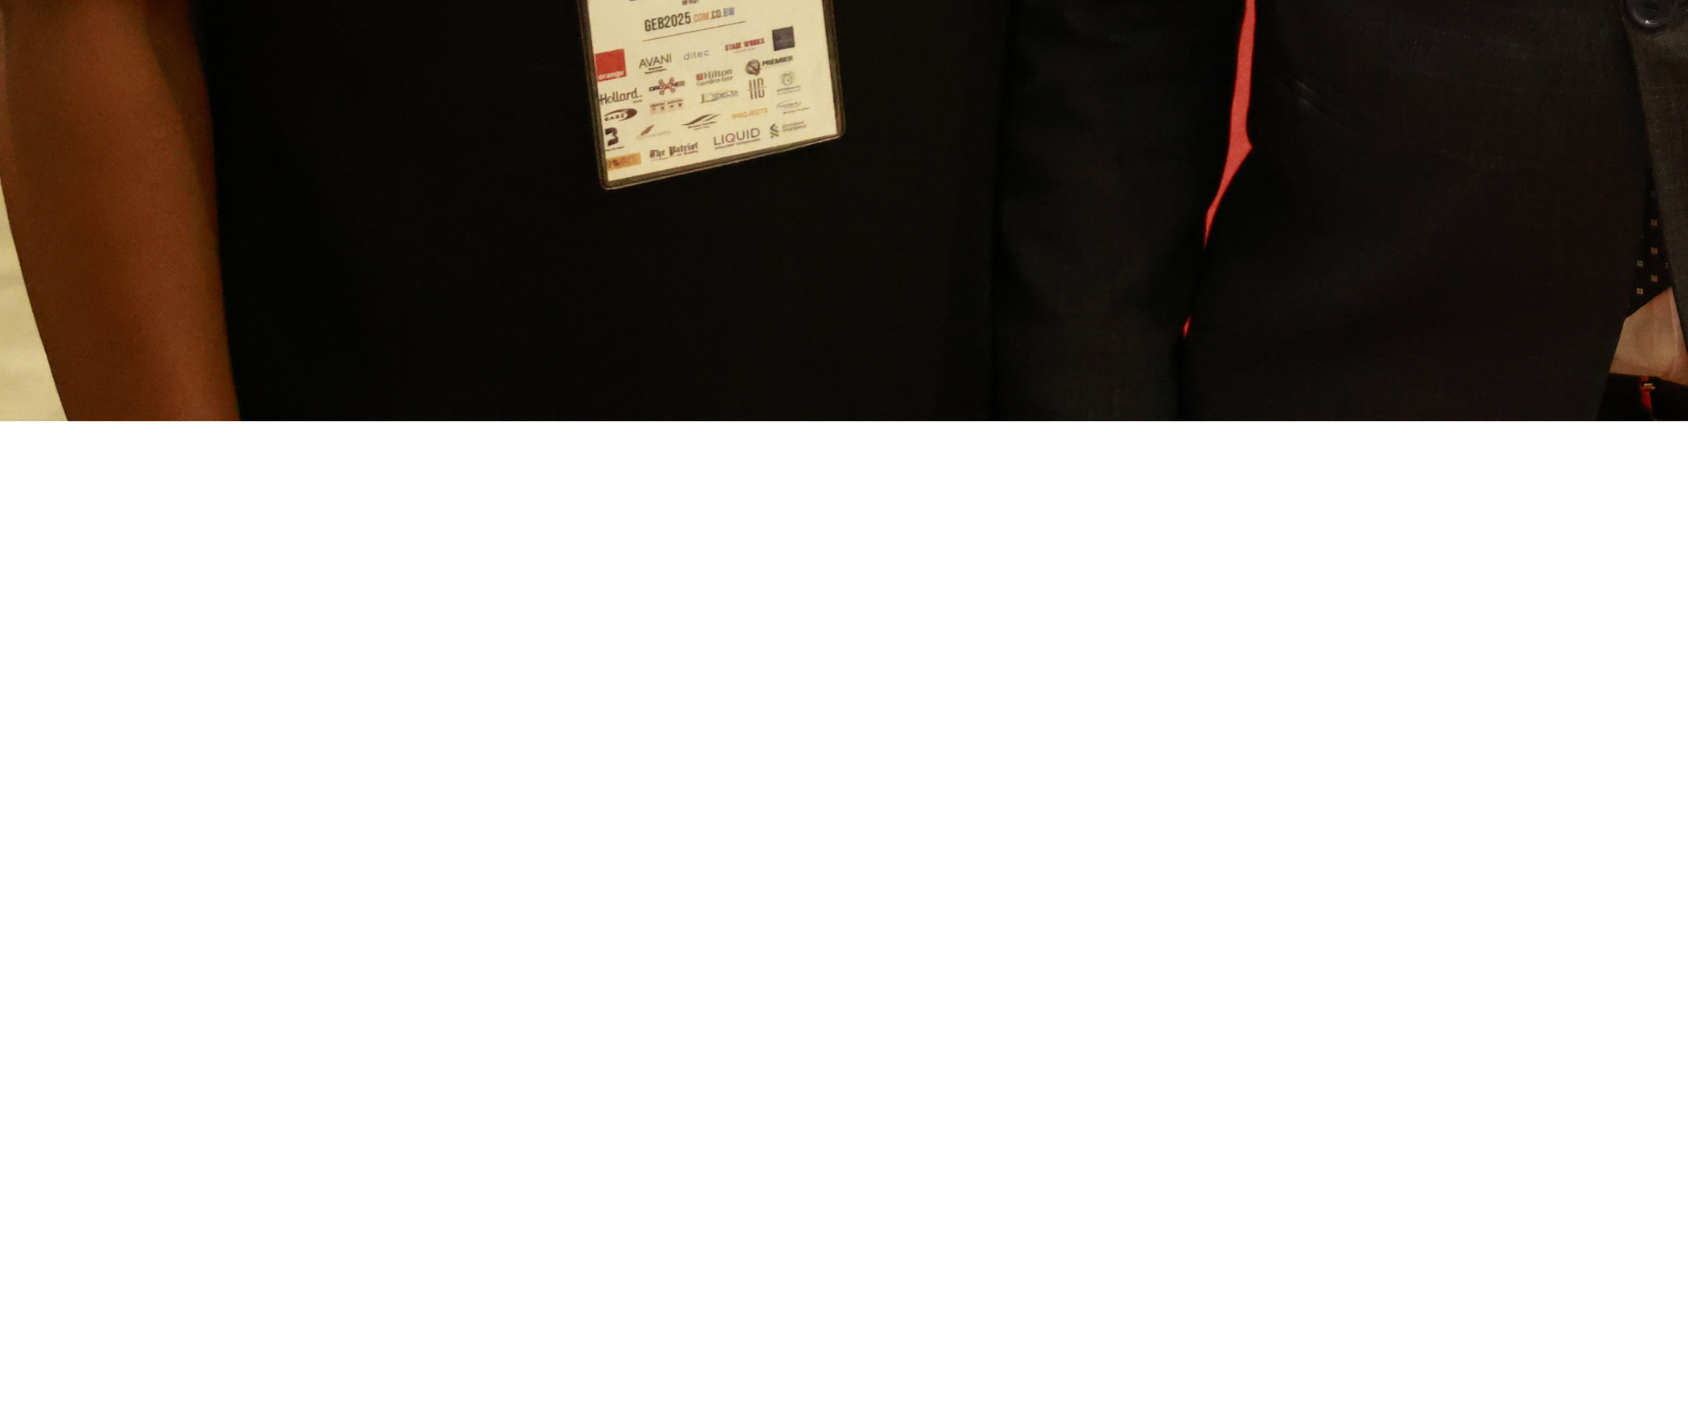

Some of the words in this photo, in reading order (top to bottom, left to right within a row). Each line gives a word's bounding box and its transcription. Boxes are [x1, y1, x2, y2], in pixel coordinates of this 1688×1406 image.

[639, 54, 672, 69] AVANI
[684, 49, 710, 61] ditec
[703, 69, 733, 80] Hilton
[713, 127, 760, 146] LIQUID
